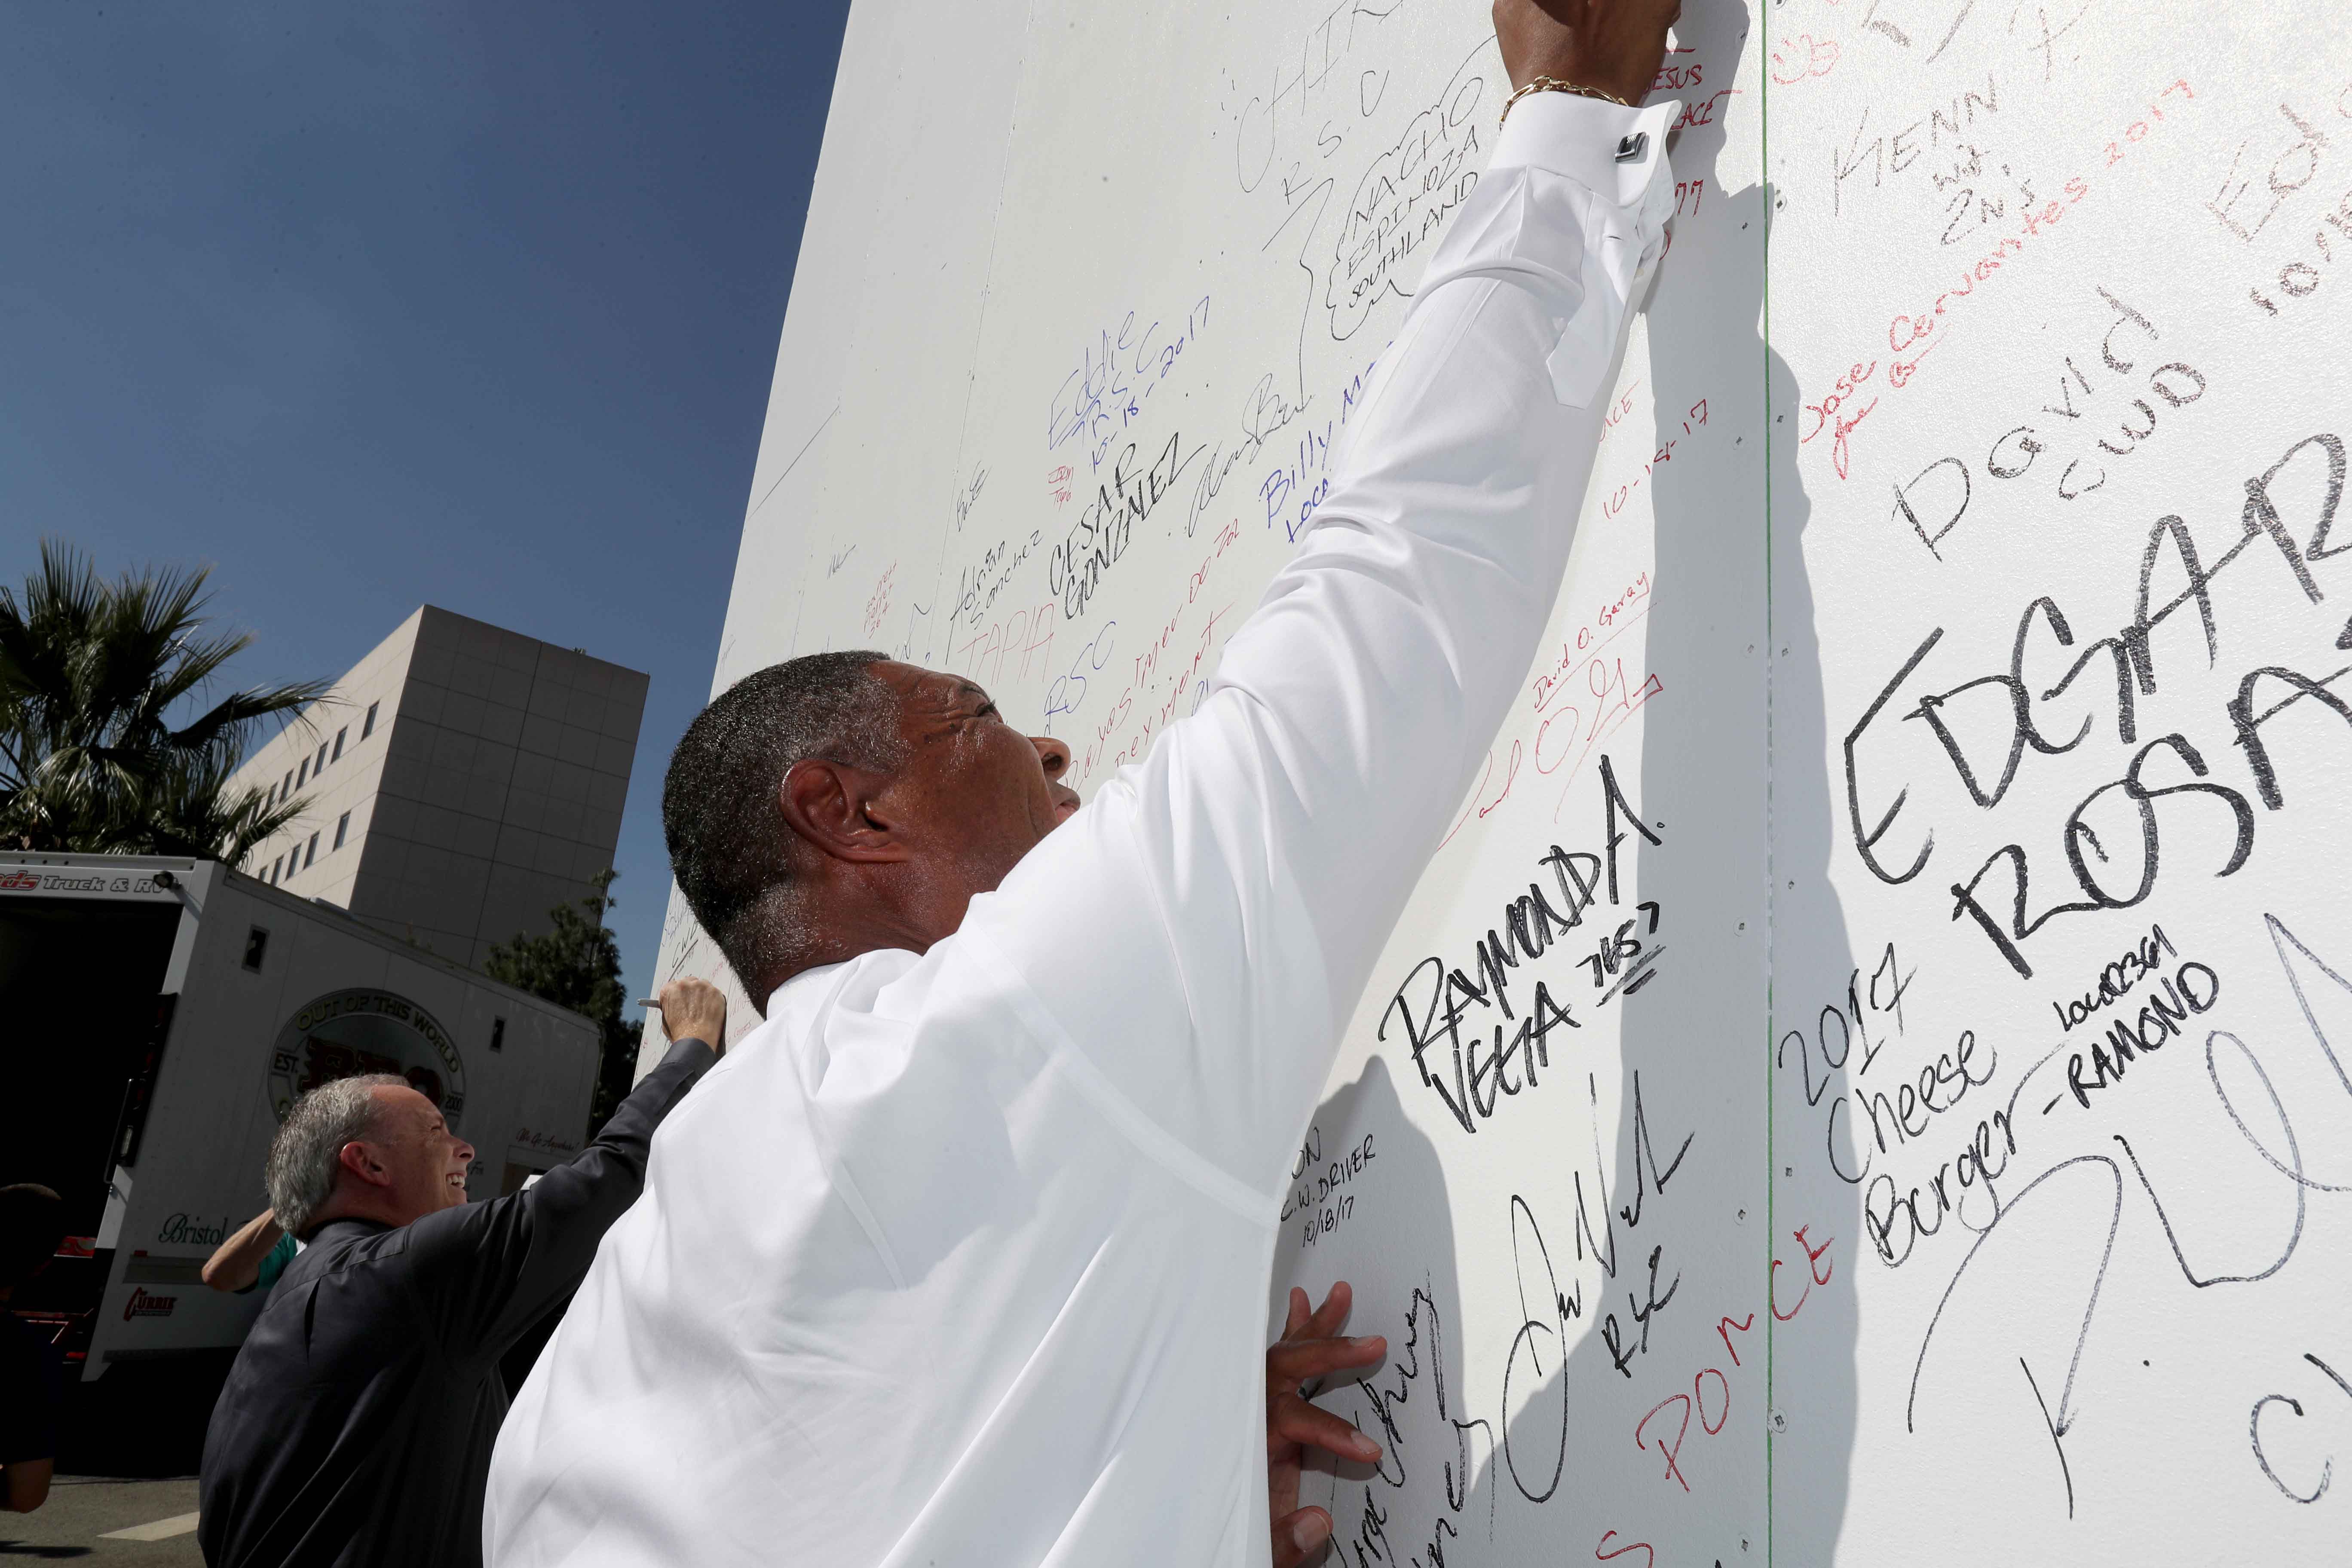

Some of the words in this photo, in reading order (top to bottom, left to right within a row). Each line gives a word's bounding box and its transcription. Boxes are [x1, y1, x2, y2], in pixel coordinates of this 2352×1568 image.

[2104, 79, 2194, 169] 2017
[1349, 172, 1479, 308] SOUTHLAND
[1050, 443, 1144, 596] CESAR
[1065, 432, 1207, 620] GONZALEZ
[1259, 419, 1333, 529] Billy
[1532, 643, 1571, 710] David
[1844, 434, 2352, 885] EDGAR
[1951, 617, 2352, 981] ROSA
[44, 875, 105, 891] Truck
[110, 878, 129, 892] &
[274, 1052, 299, 1073] EST.
[296, 999, 340, 1031] OUT
[346, 995, 369, 1011] OF
[374, 996, 411, 1019] THIS
[413, 1011, 459, 1073] WORLD
[1778, 942, 1918, 1107] 2017
[1827, 1030, 1998, 1184] Cheese
[1302, 1194, 1355, 1248] 10/18/17
[1318, 1133, 1376, 1204] DRIVER
[158, 1213, 228, 1245] Bristol
[1635, 1224, 1836, 1494] PONCE
